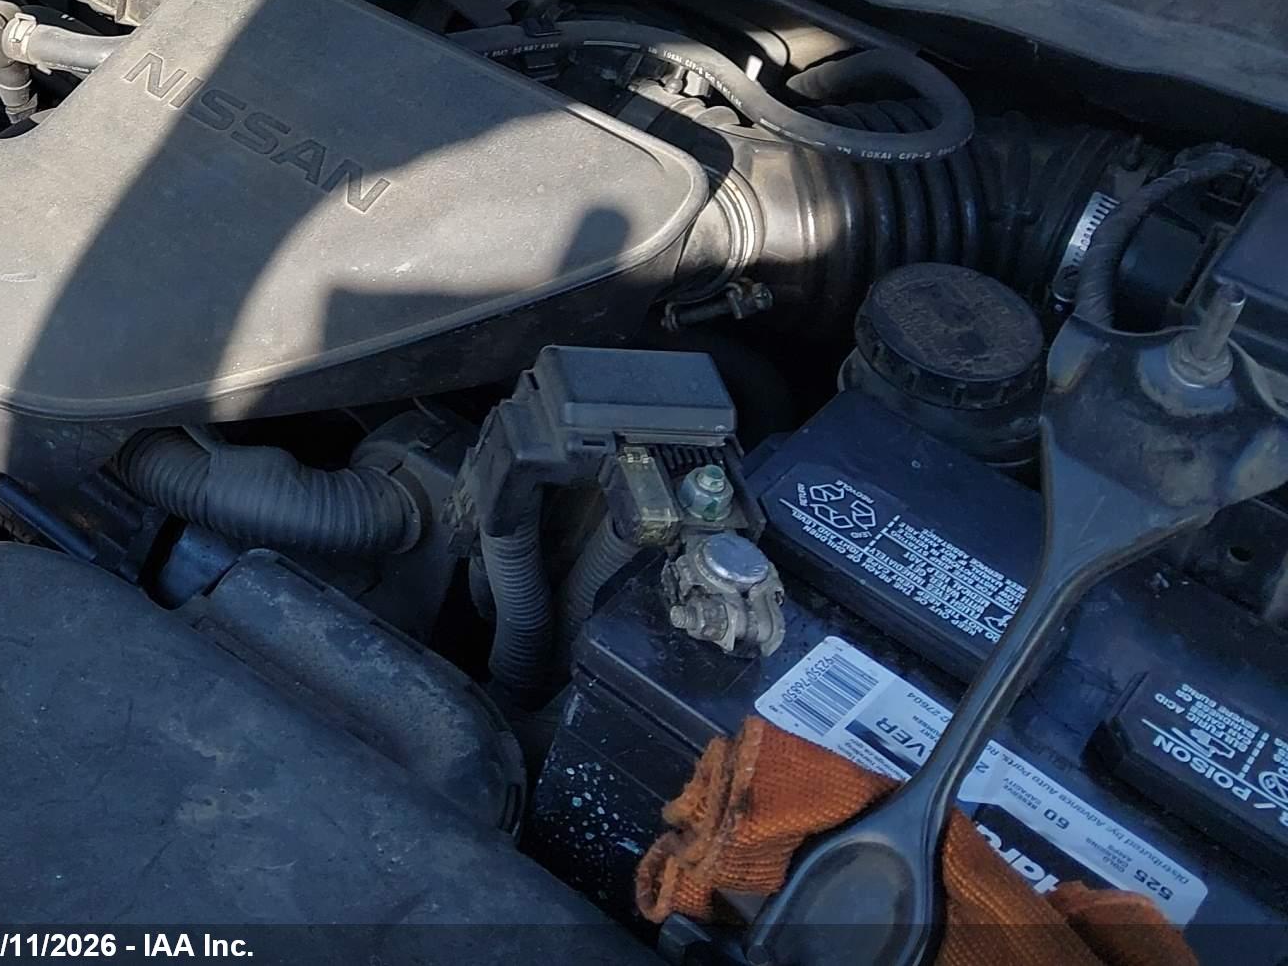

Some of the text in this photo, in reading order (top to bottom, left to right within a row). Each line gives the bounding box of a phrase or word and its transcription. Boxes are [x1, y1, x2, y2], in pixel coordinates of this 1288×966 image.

[124, 52, 392, 213] NISSAN
[836, 480, 874, 504] RECYCLE
[817, 526, 835, 539] AND
[897, 527, 928, 549] VEHICLE
[898, 521, 937, 548] AVAILABLE
[838, 539, 863, 557] TIGHT
[939, 547, 956, 559] NOT
[866, 557, 889, 573] CAPS
[890, 529, 1017, 610] TION: FOR SAFE JUMP STARTING
[907, 562, 926, 576] GET
[940, 553, 998, 592] INSTRUCTIONS
[969, 556, 1004, 581] SERVICE
[802, 524, 976, 635] KEEP OUT OF THE REACH OF CHILDREN
[868, 546, 979, 619] FLUSH EYES IMMEDIATELY
[891, 573, 914, 589] VENT
[903, 550, 989, 607] MEDICAL HELP FAST
[1004, 578, 1026, 594] SEEK
[917, 589, 940, 606] KEEP
[960, 595, 985, 613] WITH
[963, 618, 982, 632] NOT
[984, 631, 998, 642] DO
[907, 692, 941, 717] 27604
[1175, 689, 1256, 739] BLINDNESS OR
[1182, 683, 1259, 732] SEVERE BURNS
[1154, 693, 1248, 753] SULFURIC ACID
[1190, 705, 1252, 745] CAN CAUSE
[875, 717, 927, 757] VER
[1153, 734, 1252, 801] POISON
[1003, 777, 1042, 805] CAPACITY
[1030, 773, 1057, 795] Auto
[1044, 808, 1070, 830] 60
[1058, 793, 1105, 825] Advance
[1103, 855, 1125, 873] COLD
[1124, 839, 1189, 885] Distributed
[1134, 868, 1174, 901] 525
